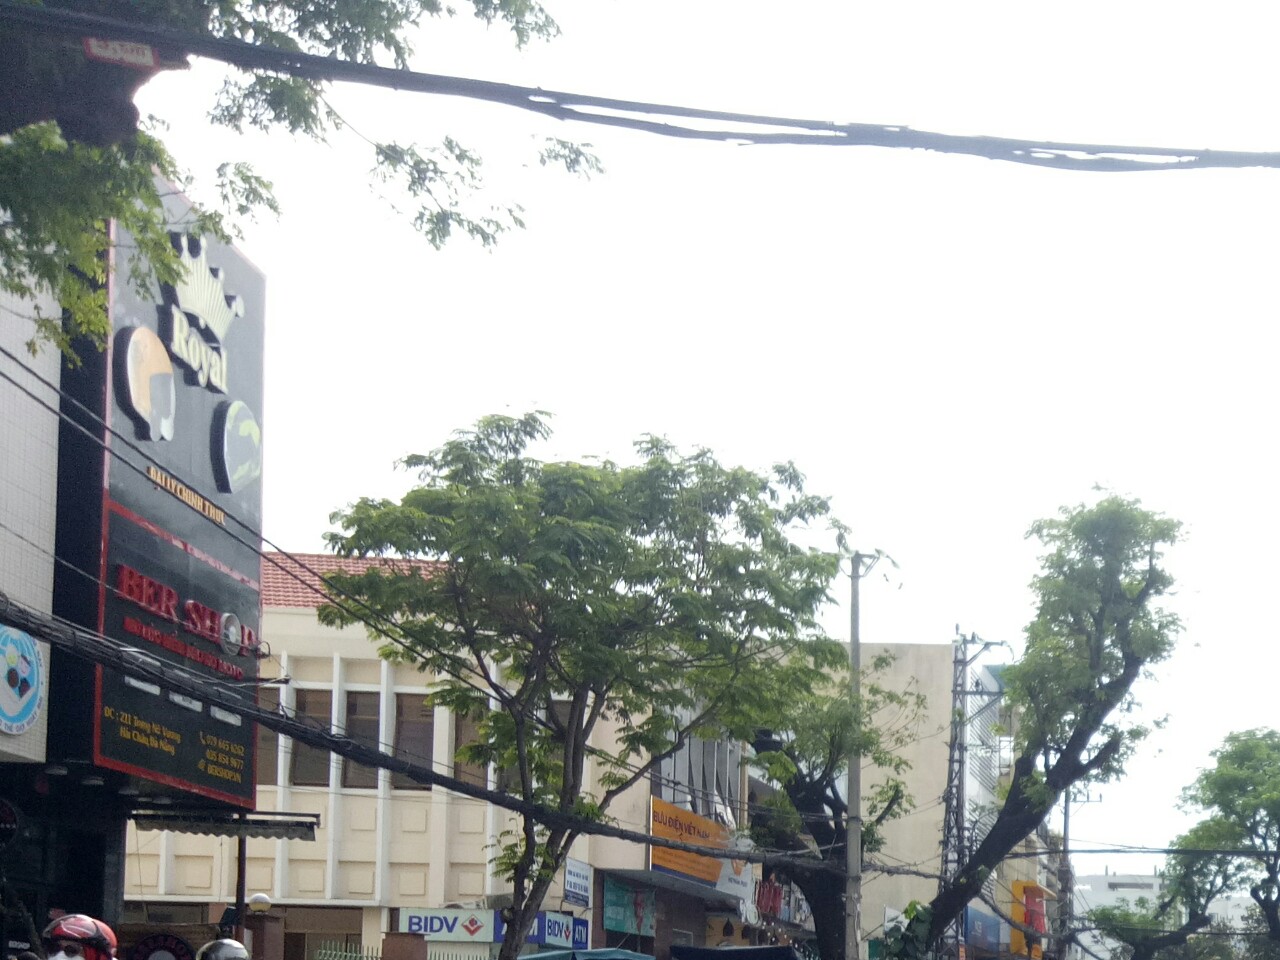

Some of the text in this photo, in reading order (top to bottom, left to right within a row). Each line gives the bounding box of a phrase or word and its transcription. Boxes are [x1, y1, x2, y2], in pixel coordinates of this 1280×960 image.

[171, 303, 229, 394] Royal
[408, 915, 458, 933] BIDV
[547, 918, 564, 938] BIDV
[574, 924, 587, 945] ATM
